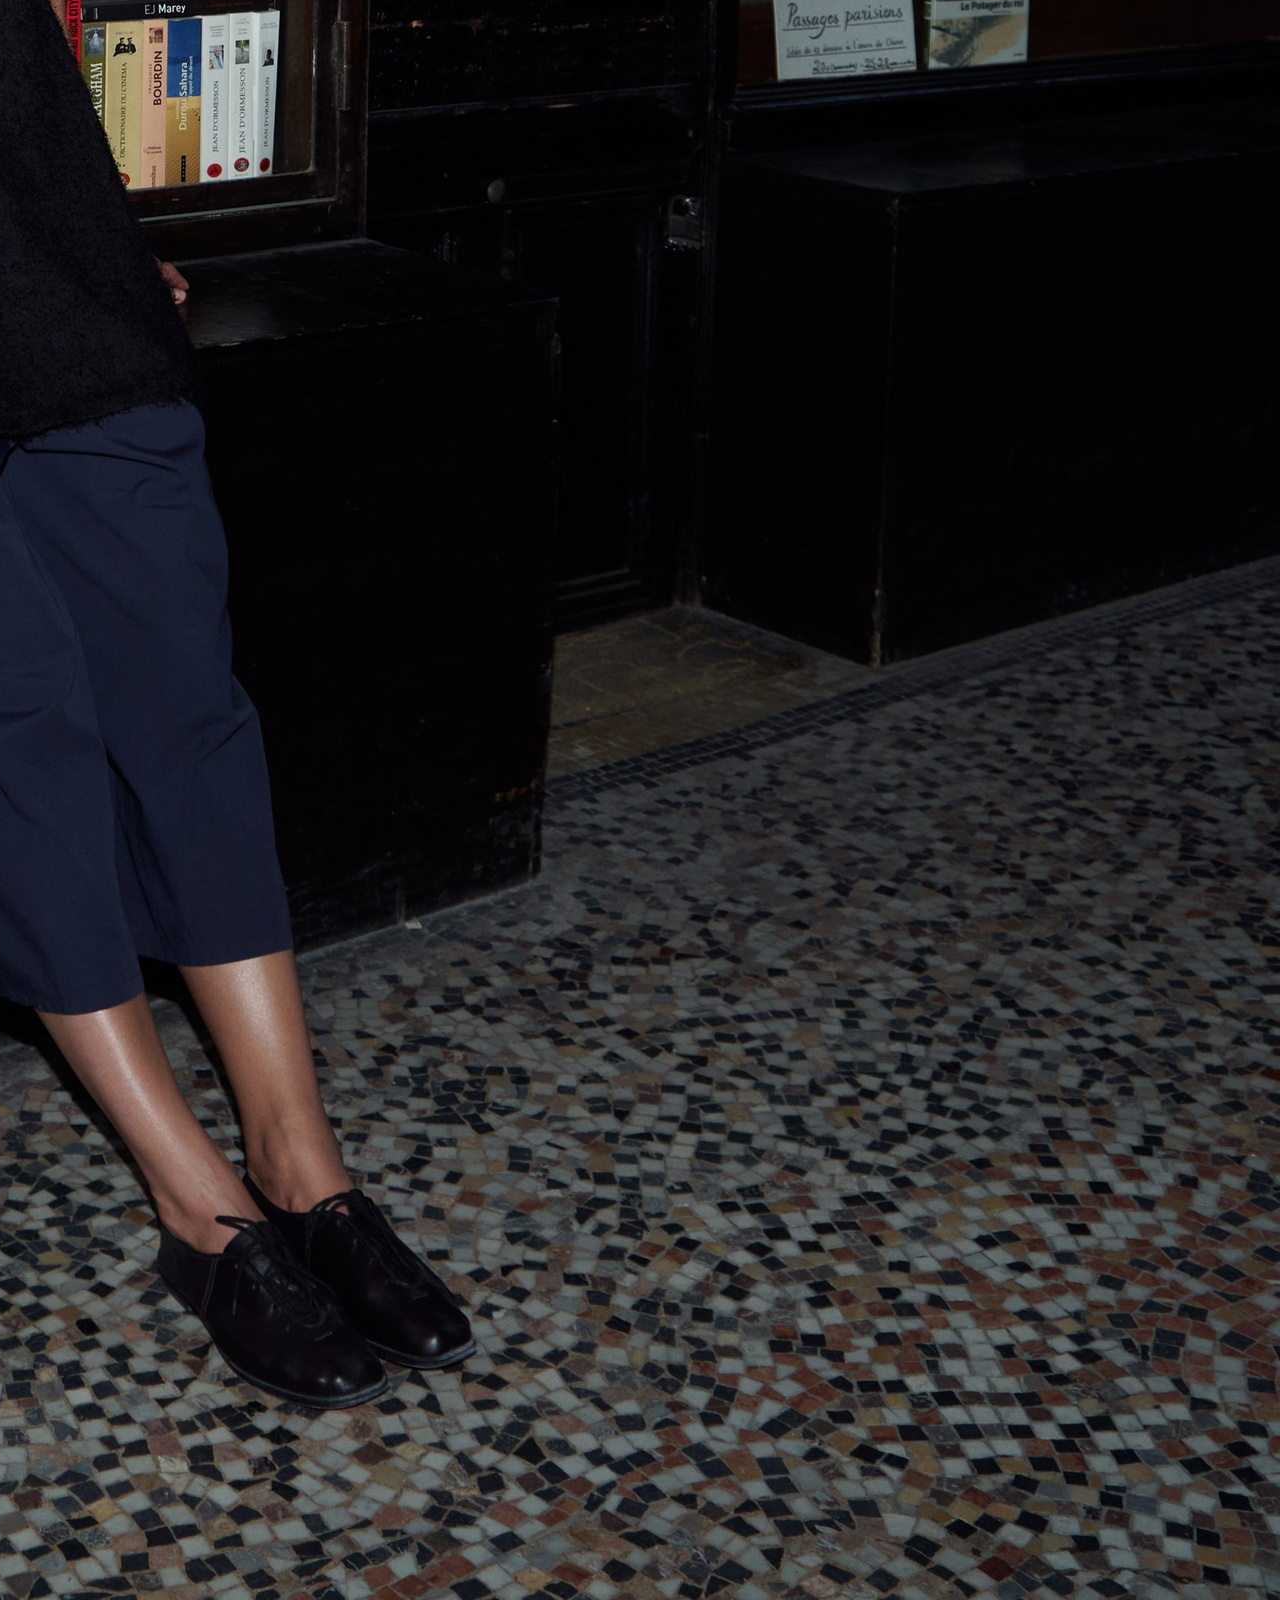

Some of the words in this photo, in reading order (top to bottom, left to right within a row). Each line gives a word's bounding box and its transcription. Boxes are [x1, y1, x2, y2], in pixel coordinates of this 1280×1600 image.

[145, 4, 156, 15] EJ
[158, 3, 186, 15] Marey
[786, 2, 840, 39] Passages
[845, 5, 904, 31] parisiens
[960, 3, 970, 11] Le
[972, 1, 1001, 13] Potager
[1002, 0, 1012, 9] du
[1013, 0, 1024, 8] roi
[153, 51, 163, 106] BOURDIN
[179, 62, 189, 97] Sahara
[178, 98, 188, 131] Durou
[238, 67, 246, 129] D'ORMESSON
[238, 131, 246, 154] JEAN
